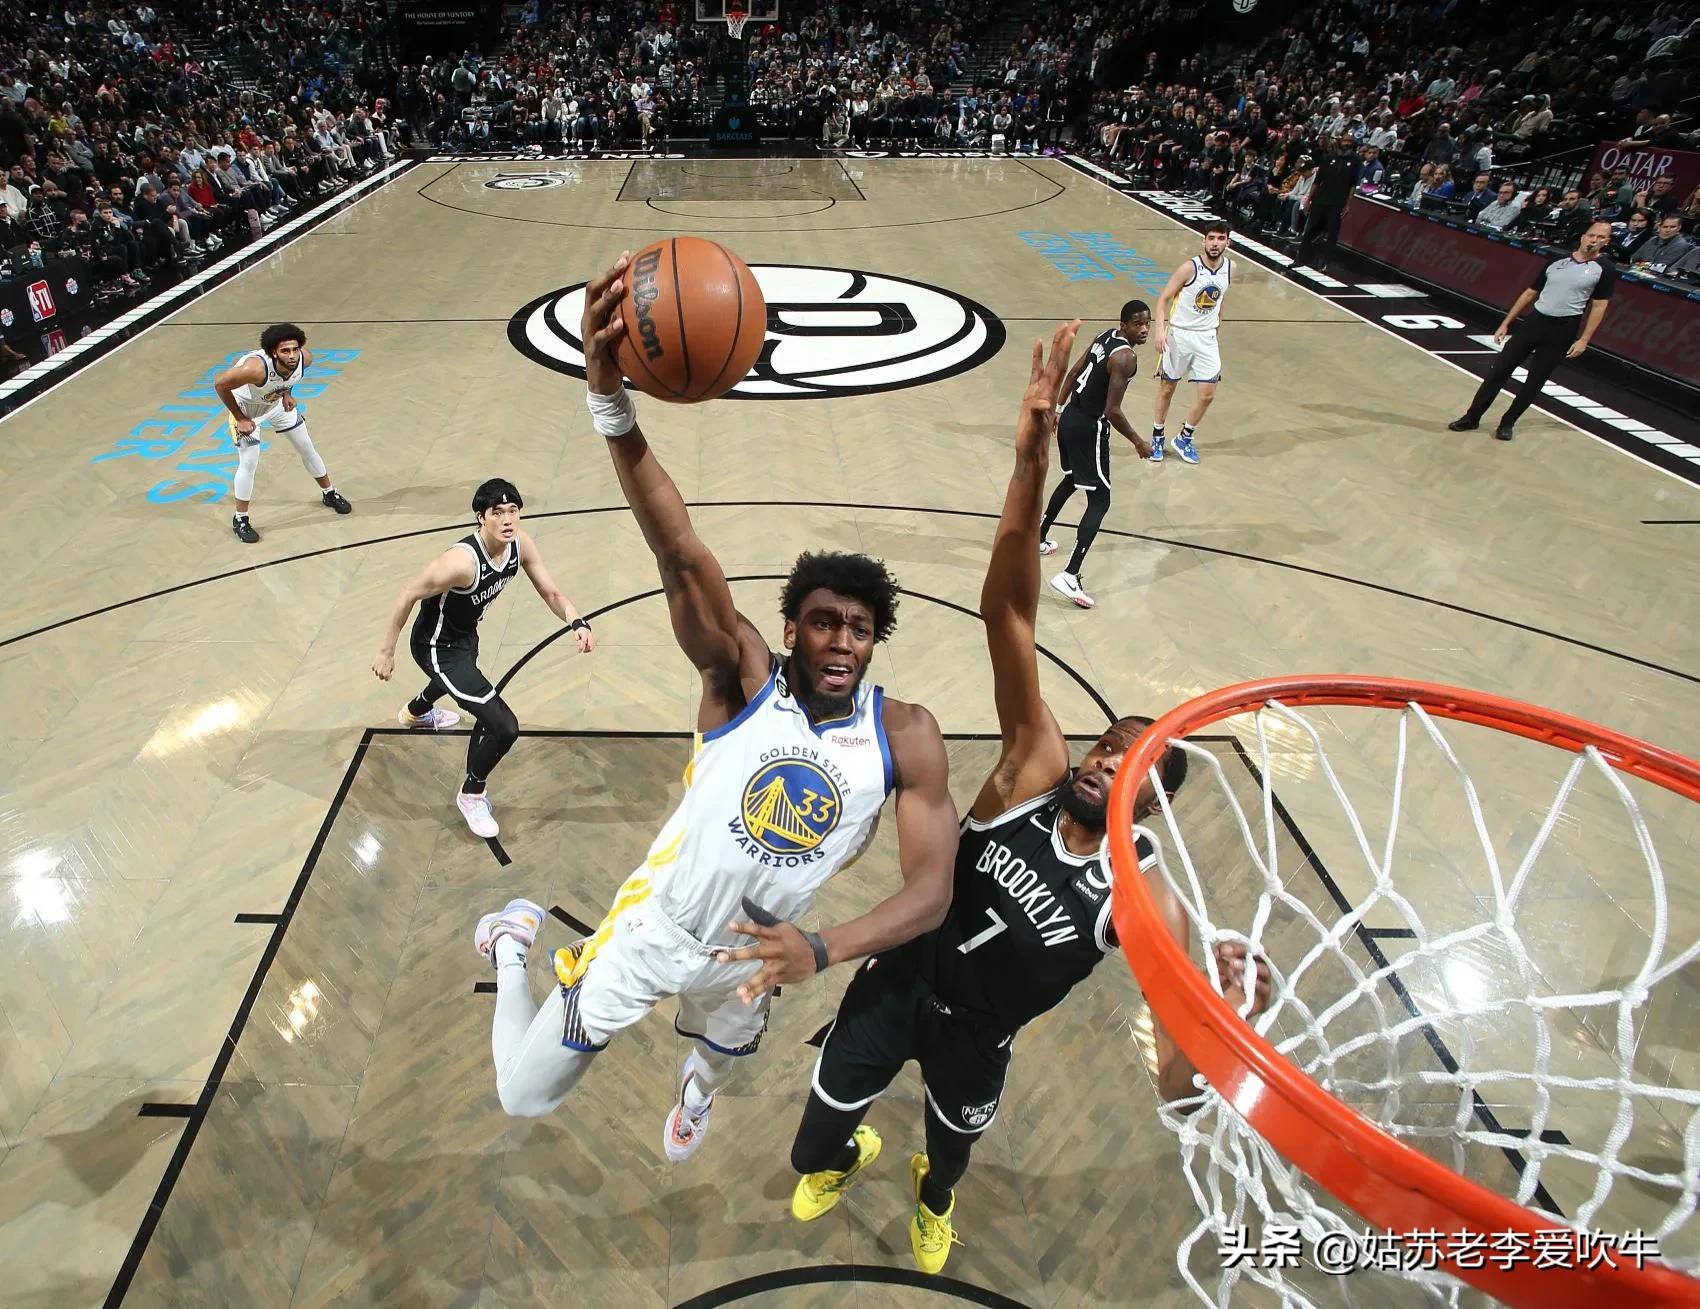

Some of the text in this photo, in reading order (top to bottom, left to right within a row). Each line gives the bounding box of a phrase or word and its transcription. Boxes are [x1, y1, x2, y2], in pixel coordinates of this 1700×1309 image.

[716, 132, 752, 141] BARCLAYS
[425, 153, 590, 162] Brooklyn
[632, 247, 664, 361] Wilson
[1381, 314, 1466, 330] 6
[1076, 361, 1094, 394] 4
[831, 735, 871, 747] Rakuten
[759, 746, 852, 796] GOLDEN STATE
[796, 788, 836, 823] 33
[728, 816, 825, 869] WARRIORS
[975, 840, 1079, 948] BROOKLYN
[957, 906, 1009, 955] 7
